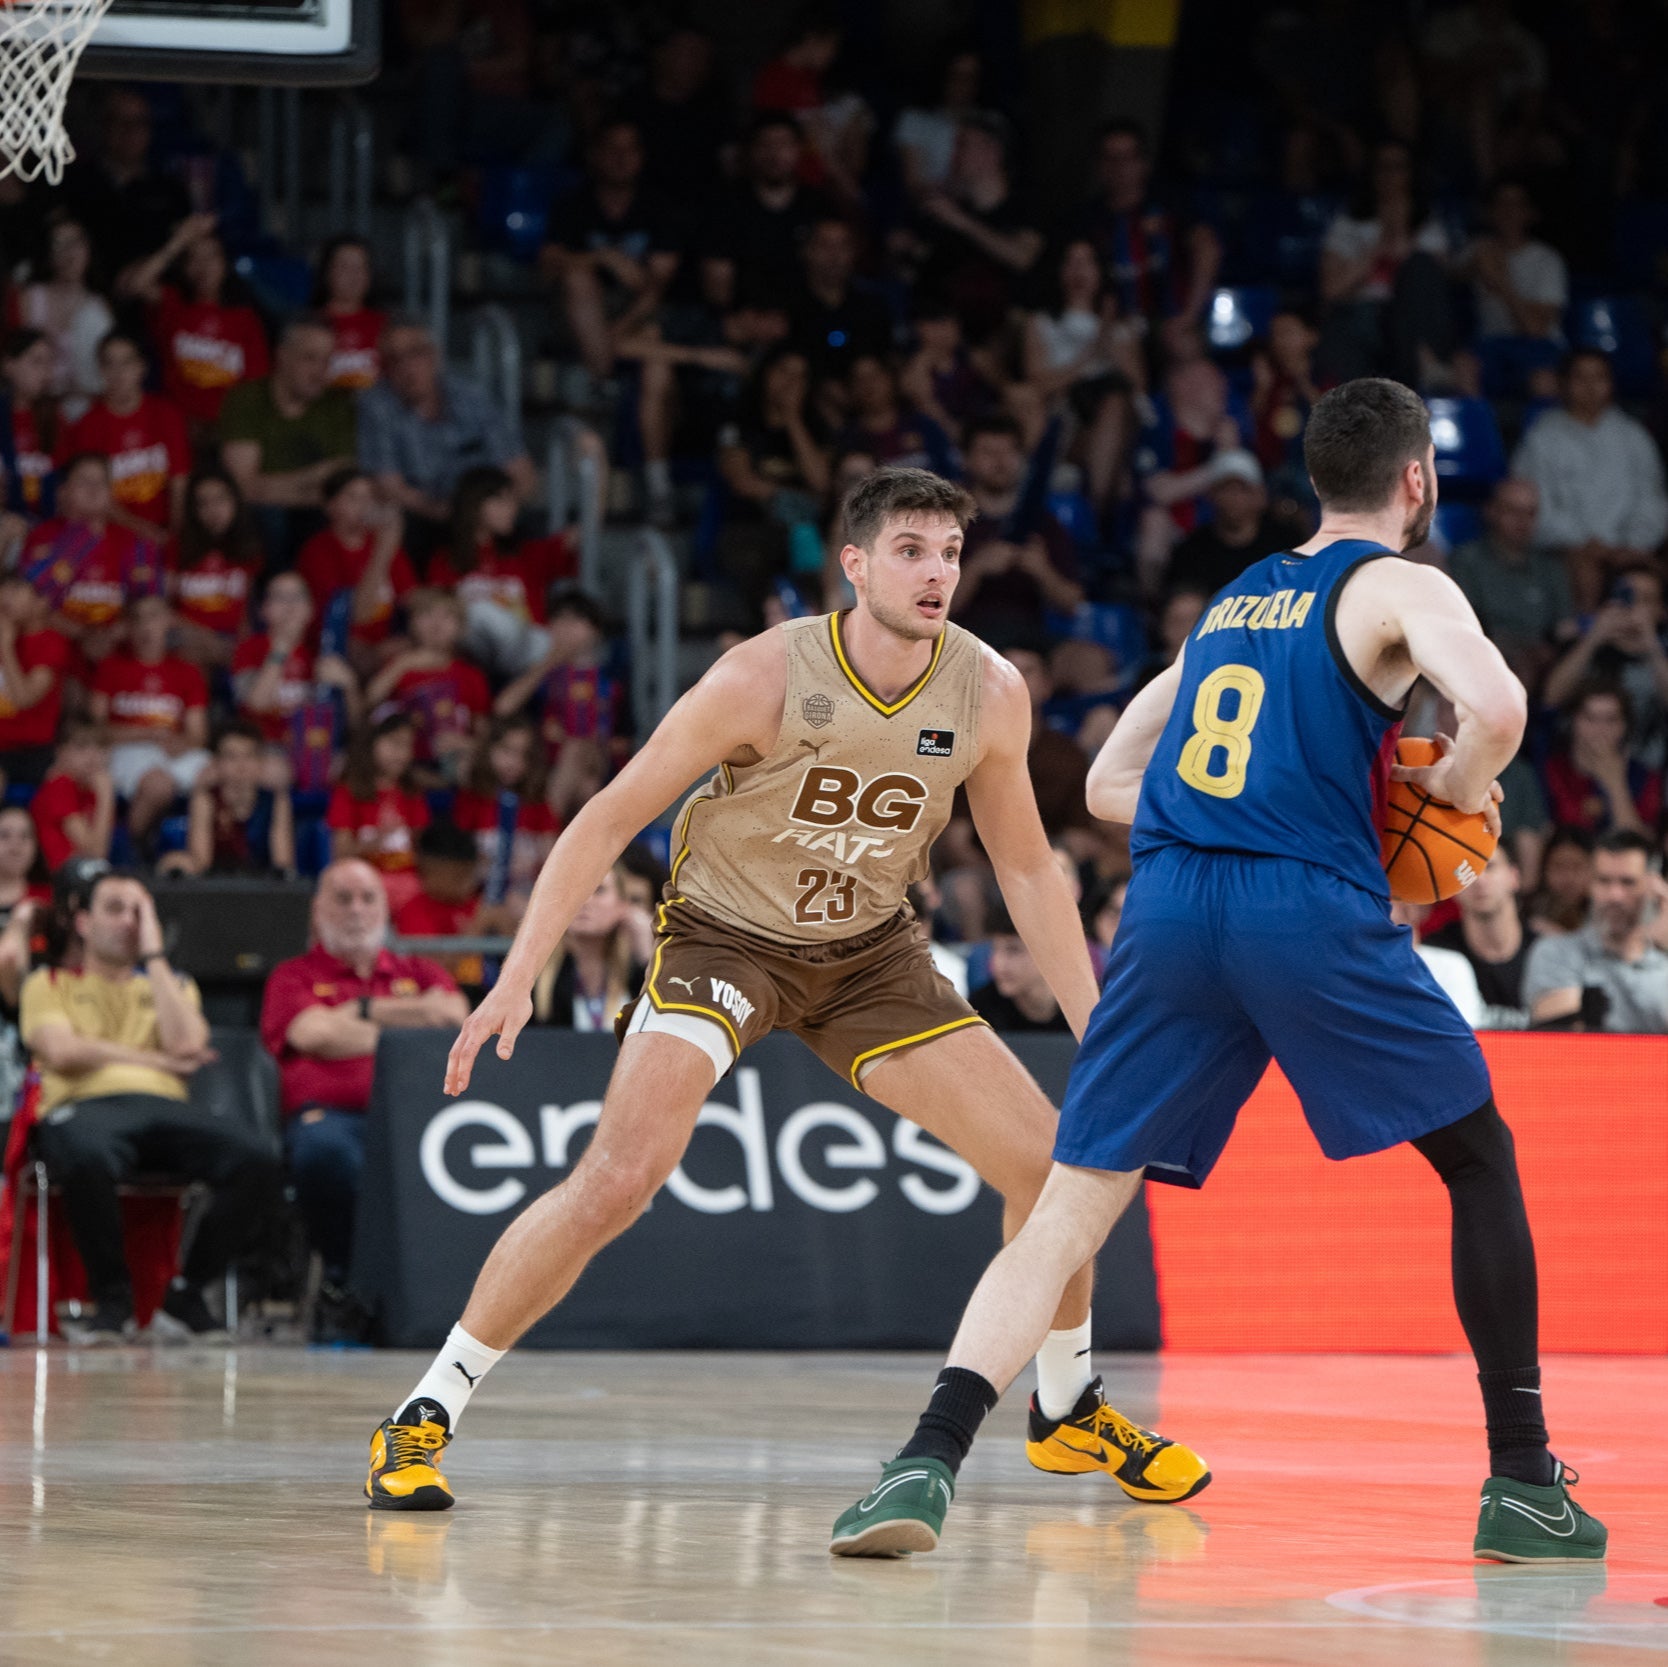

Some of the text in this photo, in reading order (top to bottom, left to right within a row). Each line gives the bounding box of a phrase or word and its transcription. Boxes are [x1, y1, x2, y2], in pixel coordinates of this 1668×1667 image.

[919, 745, 951, 755] endesa
[920, 736, 936, 747] liga
[1176, 663, 1265, 799] 8
[789, 765, 929, 833] BG
[794, 868, 858, 926] 23
